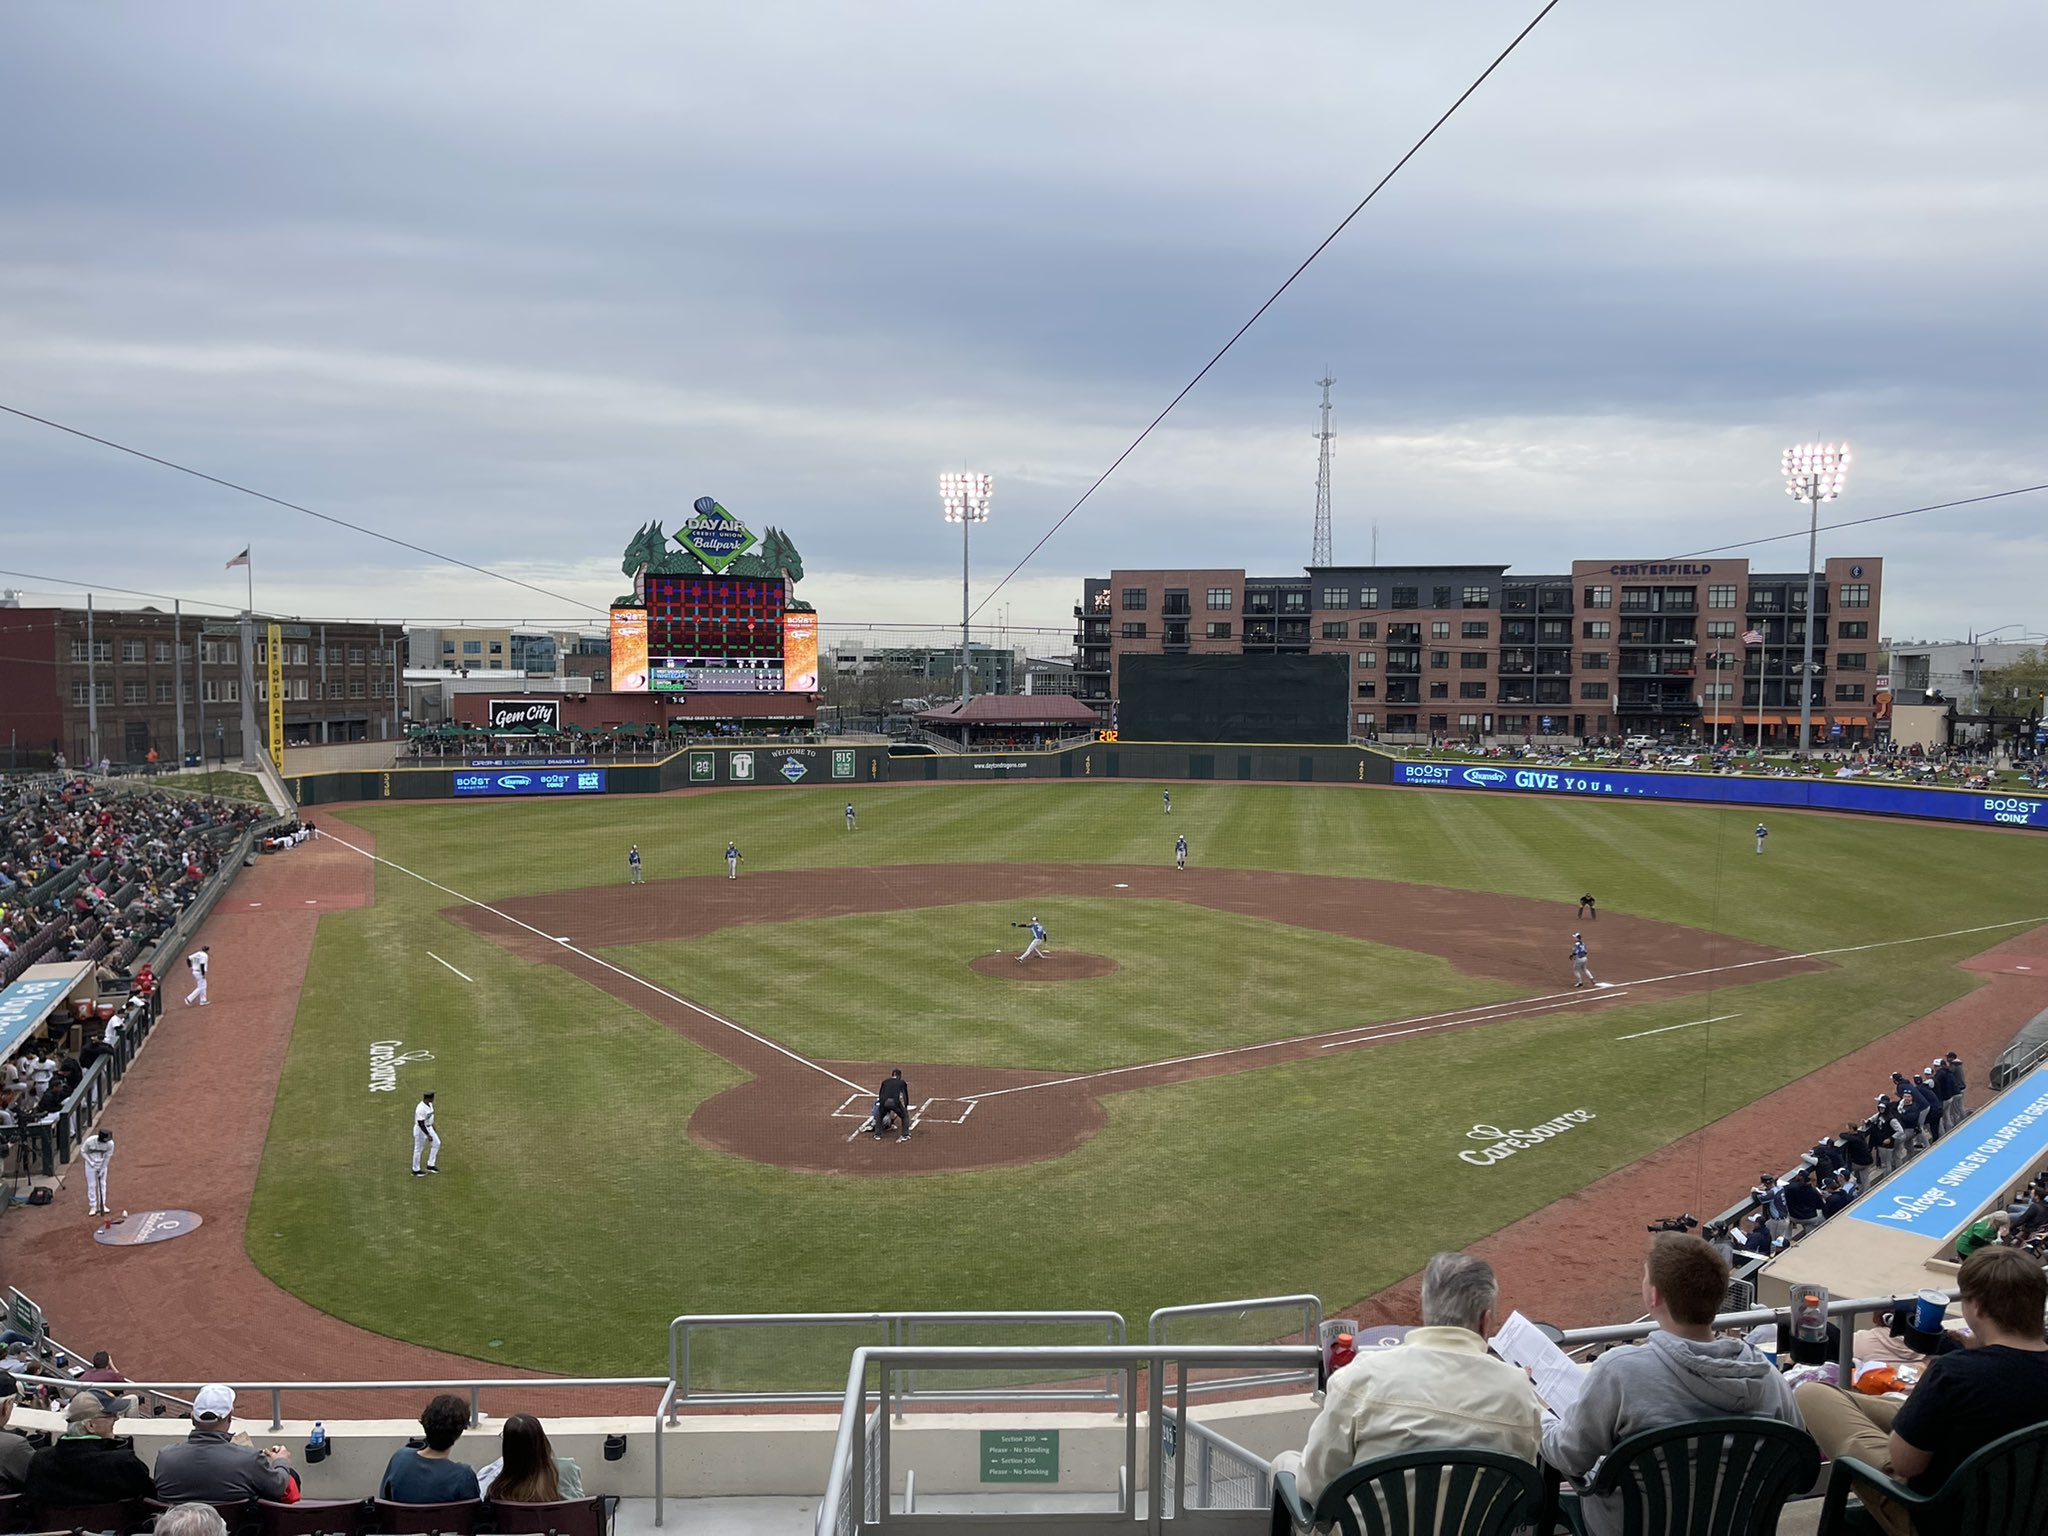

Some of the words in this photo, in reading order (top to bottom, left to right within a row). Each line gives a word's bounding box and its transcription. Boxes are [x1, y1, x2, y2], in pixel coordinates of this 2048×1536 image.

[693, 537, 740, 551] Ballpark
[1611, 564, 1712, 575] CENTERFIELD
[272, 670, 280, 699] OHIO
[496, 710, 524, 727] Gem
[526, 705, 552, 723] City
[274, 739, 282, 768] OHIO
[772, 748, 805, 758] WELCOME
[806, 749, 816, 757] TO
[836, 752, 851, 762] 815
[974, 762, 1028, 770] www.daytondragons.com
[1406, 764, 1452, 778] BOOST
[457, 776, 490, 786] BOOST
[540, 774, 570, 783] BOOST
[1515, 770, 1558, 790] GIVE
[1565, 778, 1612, 792] YOUR
[1984, 798, 2042, 814] BOOST
[1994, 812, 2028, 824] COINZ
[2008, 1114, 2038, 1128] FOR
[1458, 1109, 1596, 1166] CareSource
[1994, 1126, 2022, 1140] APP
[1984, 1138, 2009, 1154] OUR
[1966, 1147, 1991, 1165] BY
[1937, 1160, 1981, 1187] SWING
[1893, 1187, 1956, 1217] Kroger
